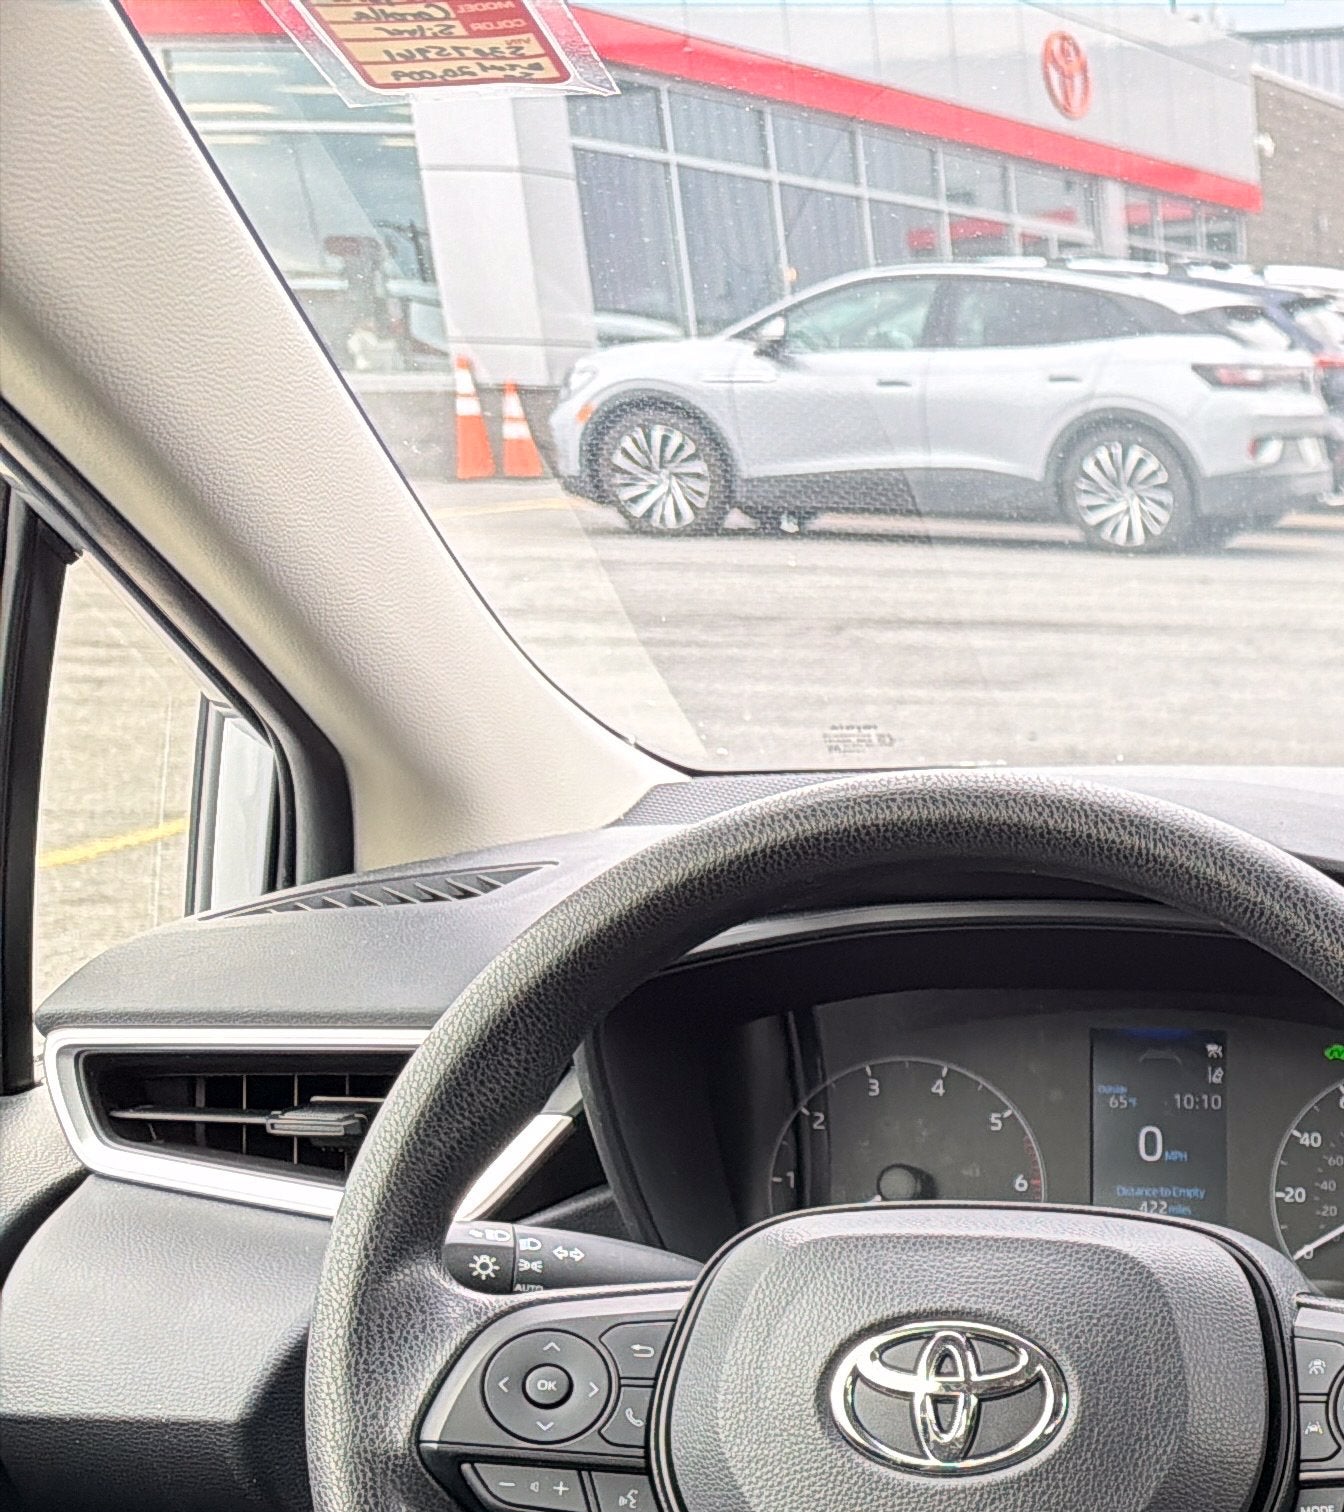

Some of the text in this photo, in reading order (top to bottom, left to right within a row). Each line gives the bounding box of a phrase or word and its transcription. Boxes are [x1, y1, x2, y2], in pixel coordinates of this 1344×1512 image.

[868, 1079, 880, 1096] 3
[931, 1079, 946, 1096] 4
[1173, 1092, 1223, 1111] 10:10
[812, 1112, 825, 1130] 2
[990, 1113, 1003, 1131] 5
[1139, 1125, 1163, 1162] 0
[1299, 1132, 1322, 1148] 40
[1327, 1155, 1344, 1166] 60
[786, 1171, 795, 1189] 1
[1014, 1174, 1028, 1192] 6
[1320, 1180, 1337, 1192] 40
[1116, 1184, 1206, 1200] Distance to Empty
[1284, 1186, 1307, 1203] 20
[1139, 1200, 1168, 1214] 422
[1321, 1205, 1338, 1217] 20
[536, 1379, 557, 1391] OK
